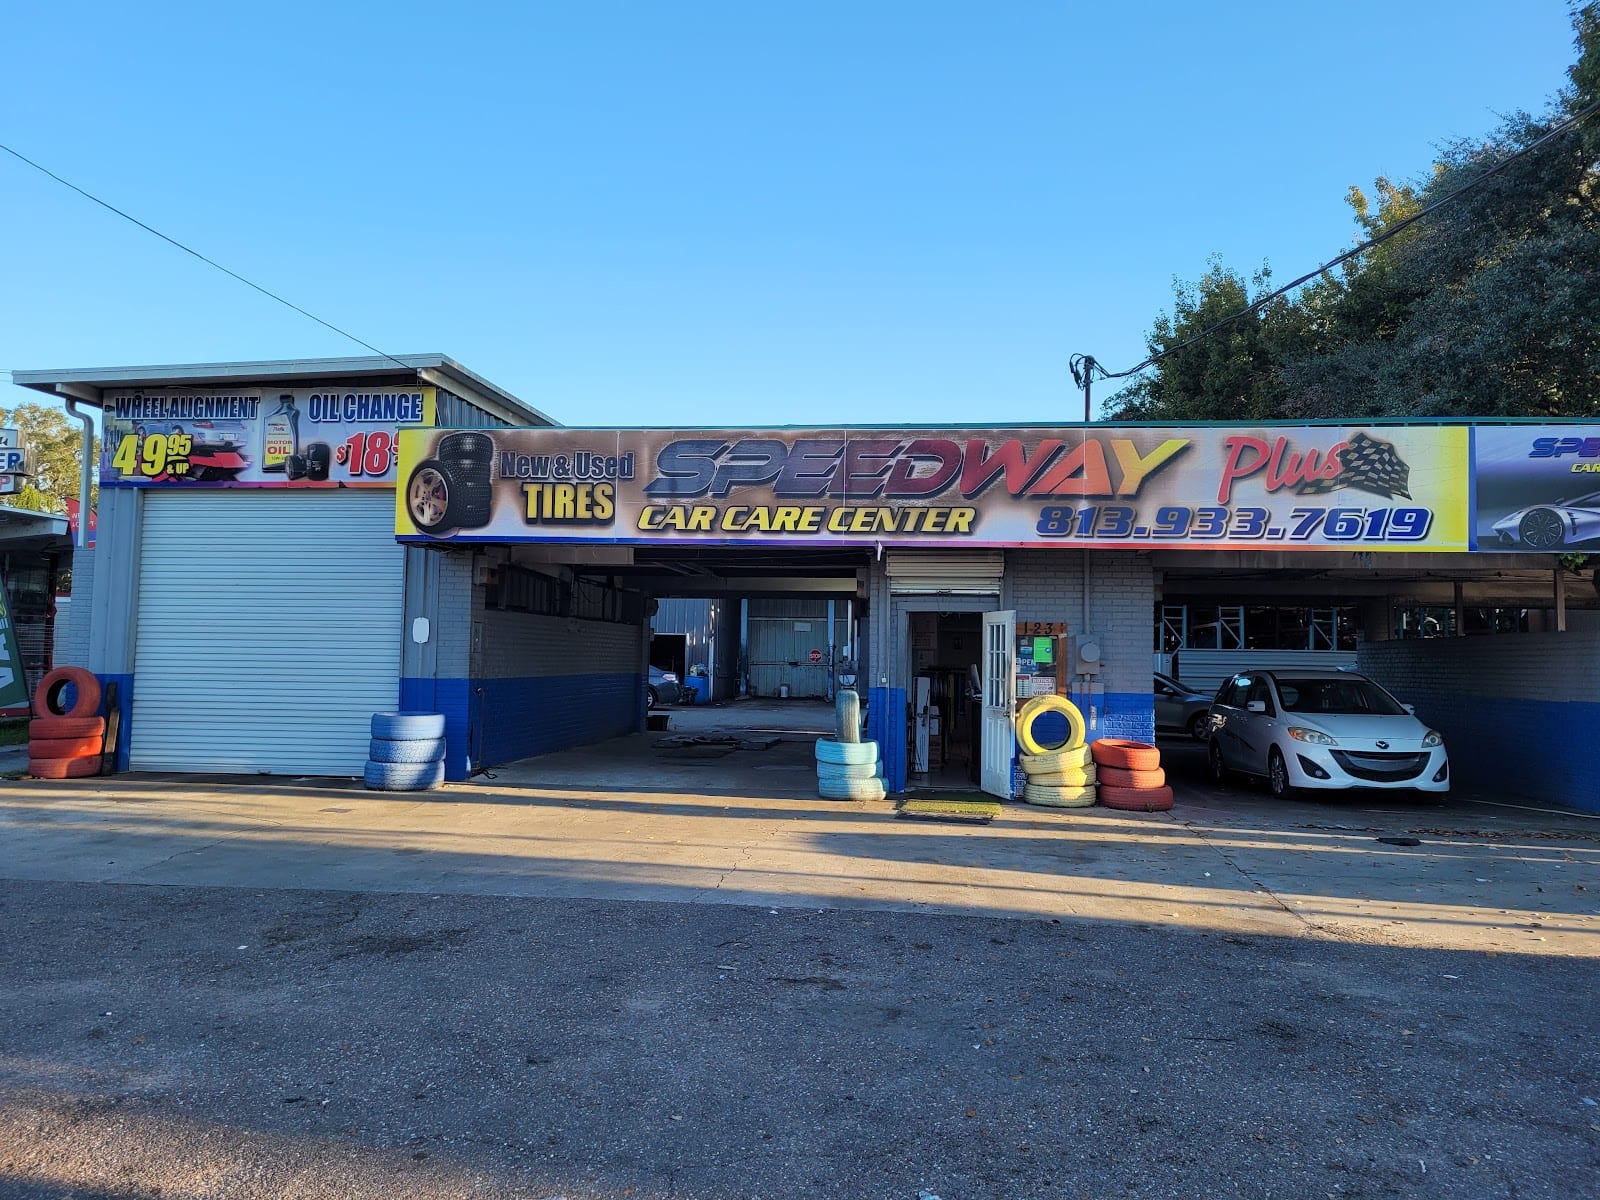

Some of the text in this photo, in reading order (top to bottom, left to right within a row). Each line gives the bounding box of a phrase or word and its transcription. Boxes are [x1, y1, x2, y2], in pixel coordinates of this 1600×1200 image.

[115, 395, 260, 419] WHEEL ALIGNMENT
[308, 392, 424, 421] OIL CHANGE
[267, 446, 291, 455] OIL
[500, 450, 635, 479] New & Used
[177, 463, 189, 475] UP
[643, 433, 1351, 505] SPEEDWAY Plus
[522, 482, 614, 524] TIRES
[637, 505, 977, 535] CAR CARE CENTER
[1035, 505, 1434, 540] 813.933.7619
